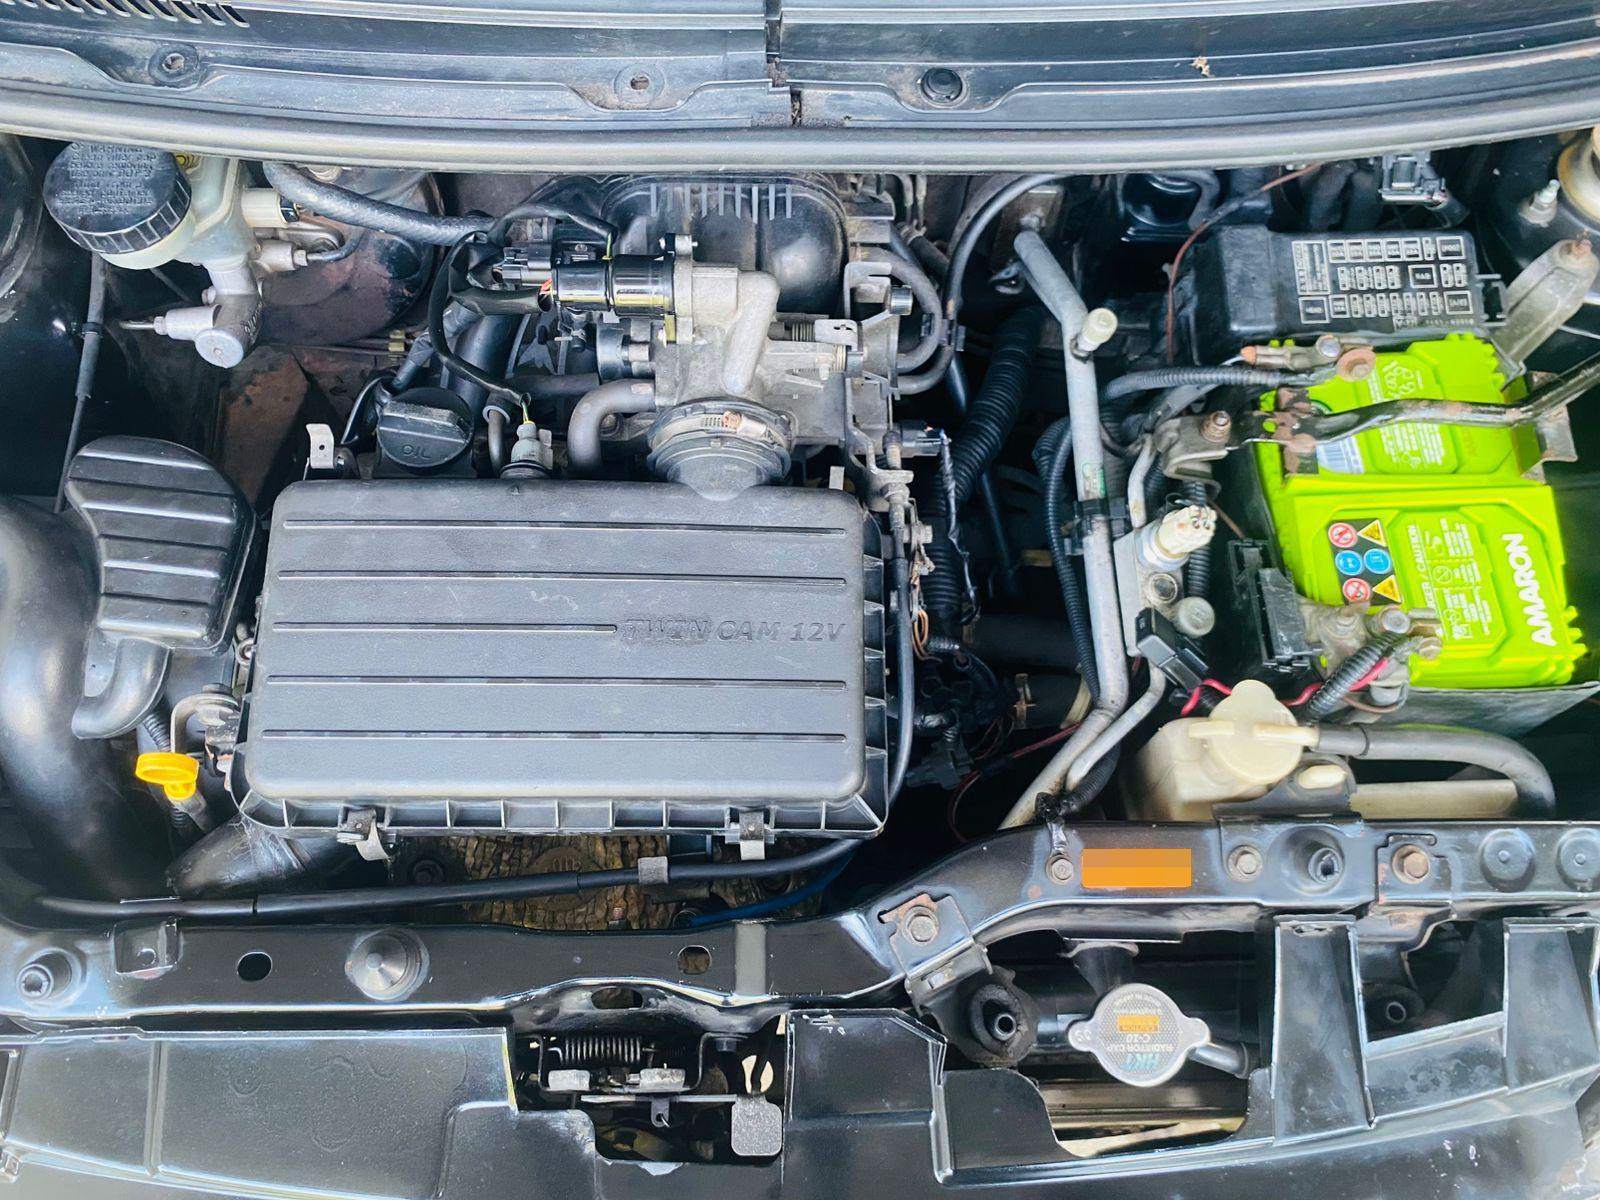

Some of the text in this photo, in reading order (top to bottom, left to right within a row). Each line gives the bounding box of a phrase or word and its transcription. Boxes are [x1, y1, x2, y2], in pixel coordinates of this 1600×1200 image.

[402, 444, 432, 460] OIL
[1501, 533, 1557, 647] AMARON
[717, 620, 781, 641] CAM
[789, 622, 847, 643] 12V
